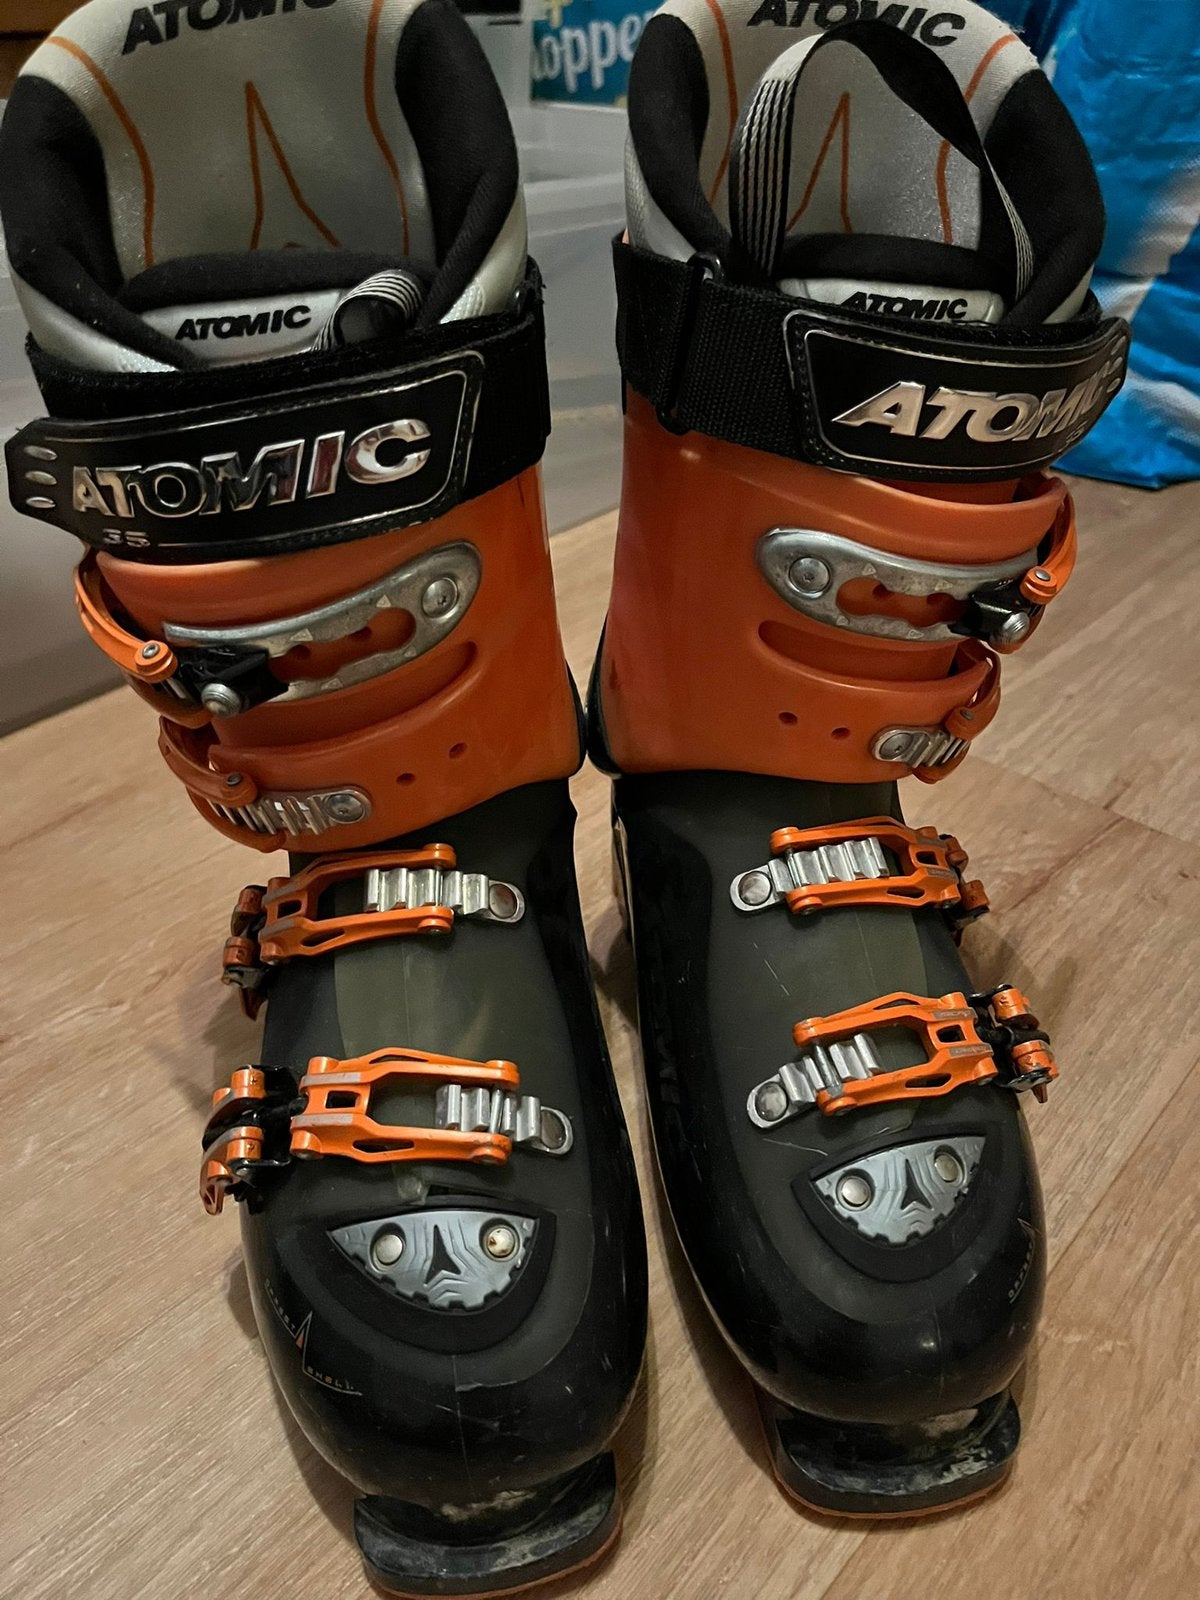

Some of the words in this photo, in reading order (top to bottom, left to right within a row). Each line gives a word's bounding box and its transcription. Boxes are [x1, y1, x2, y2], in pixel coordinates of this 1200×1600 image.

[121, 0, 338, 56] ATOM
[174, 305, 312, 341] ATOMIC
[838, 291, 968, 321] ATOMIC
[73, 418, 431, 518] ATOMIC
[103, 528, 151, 548] 35
